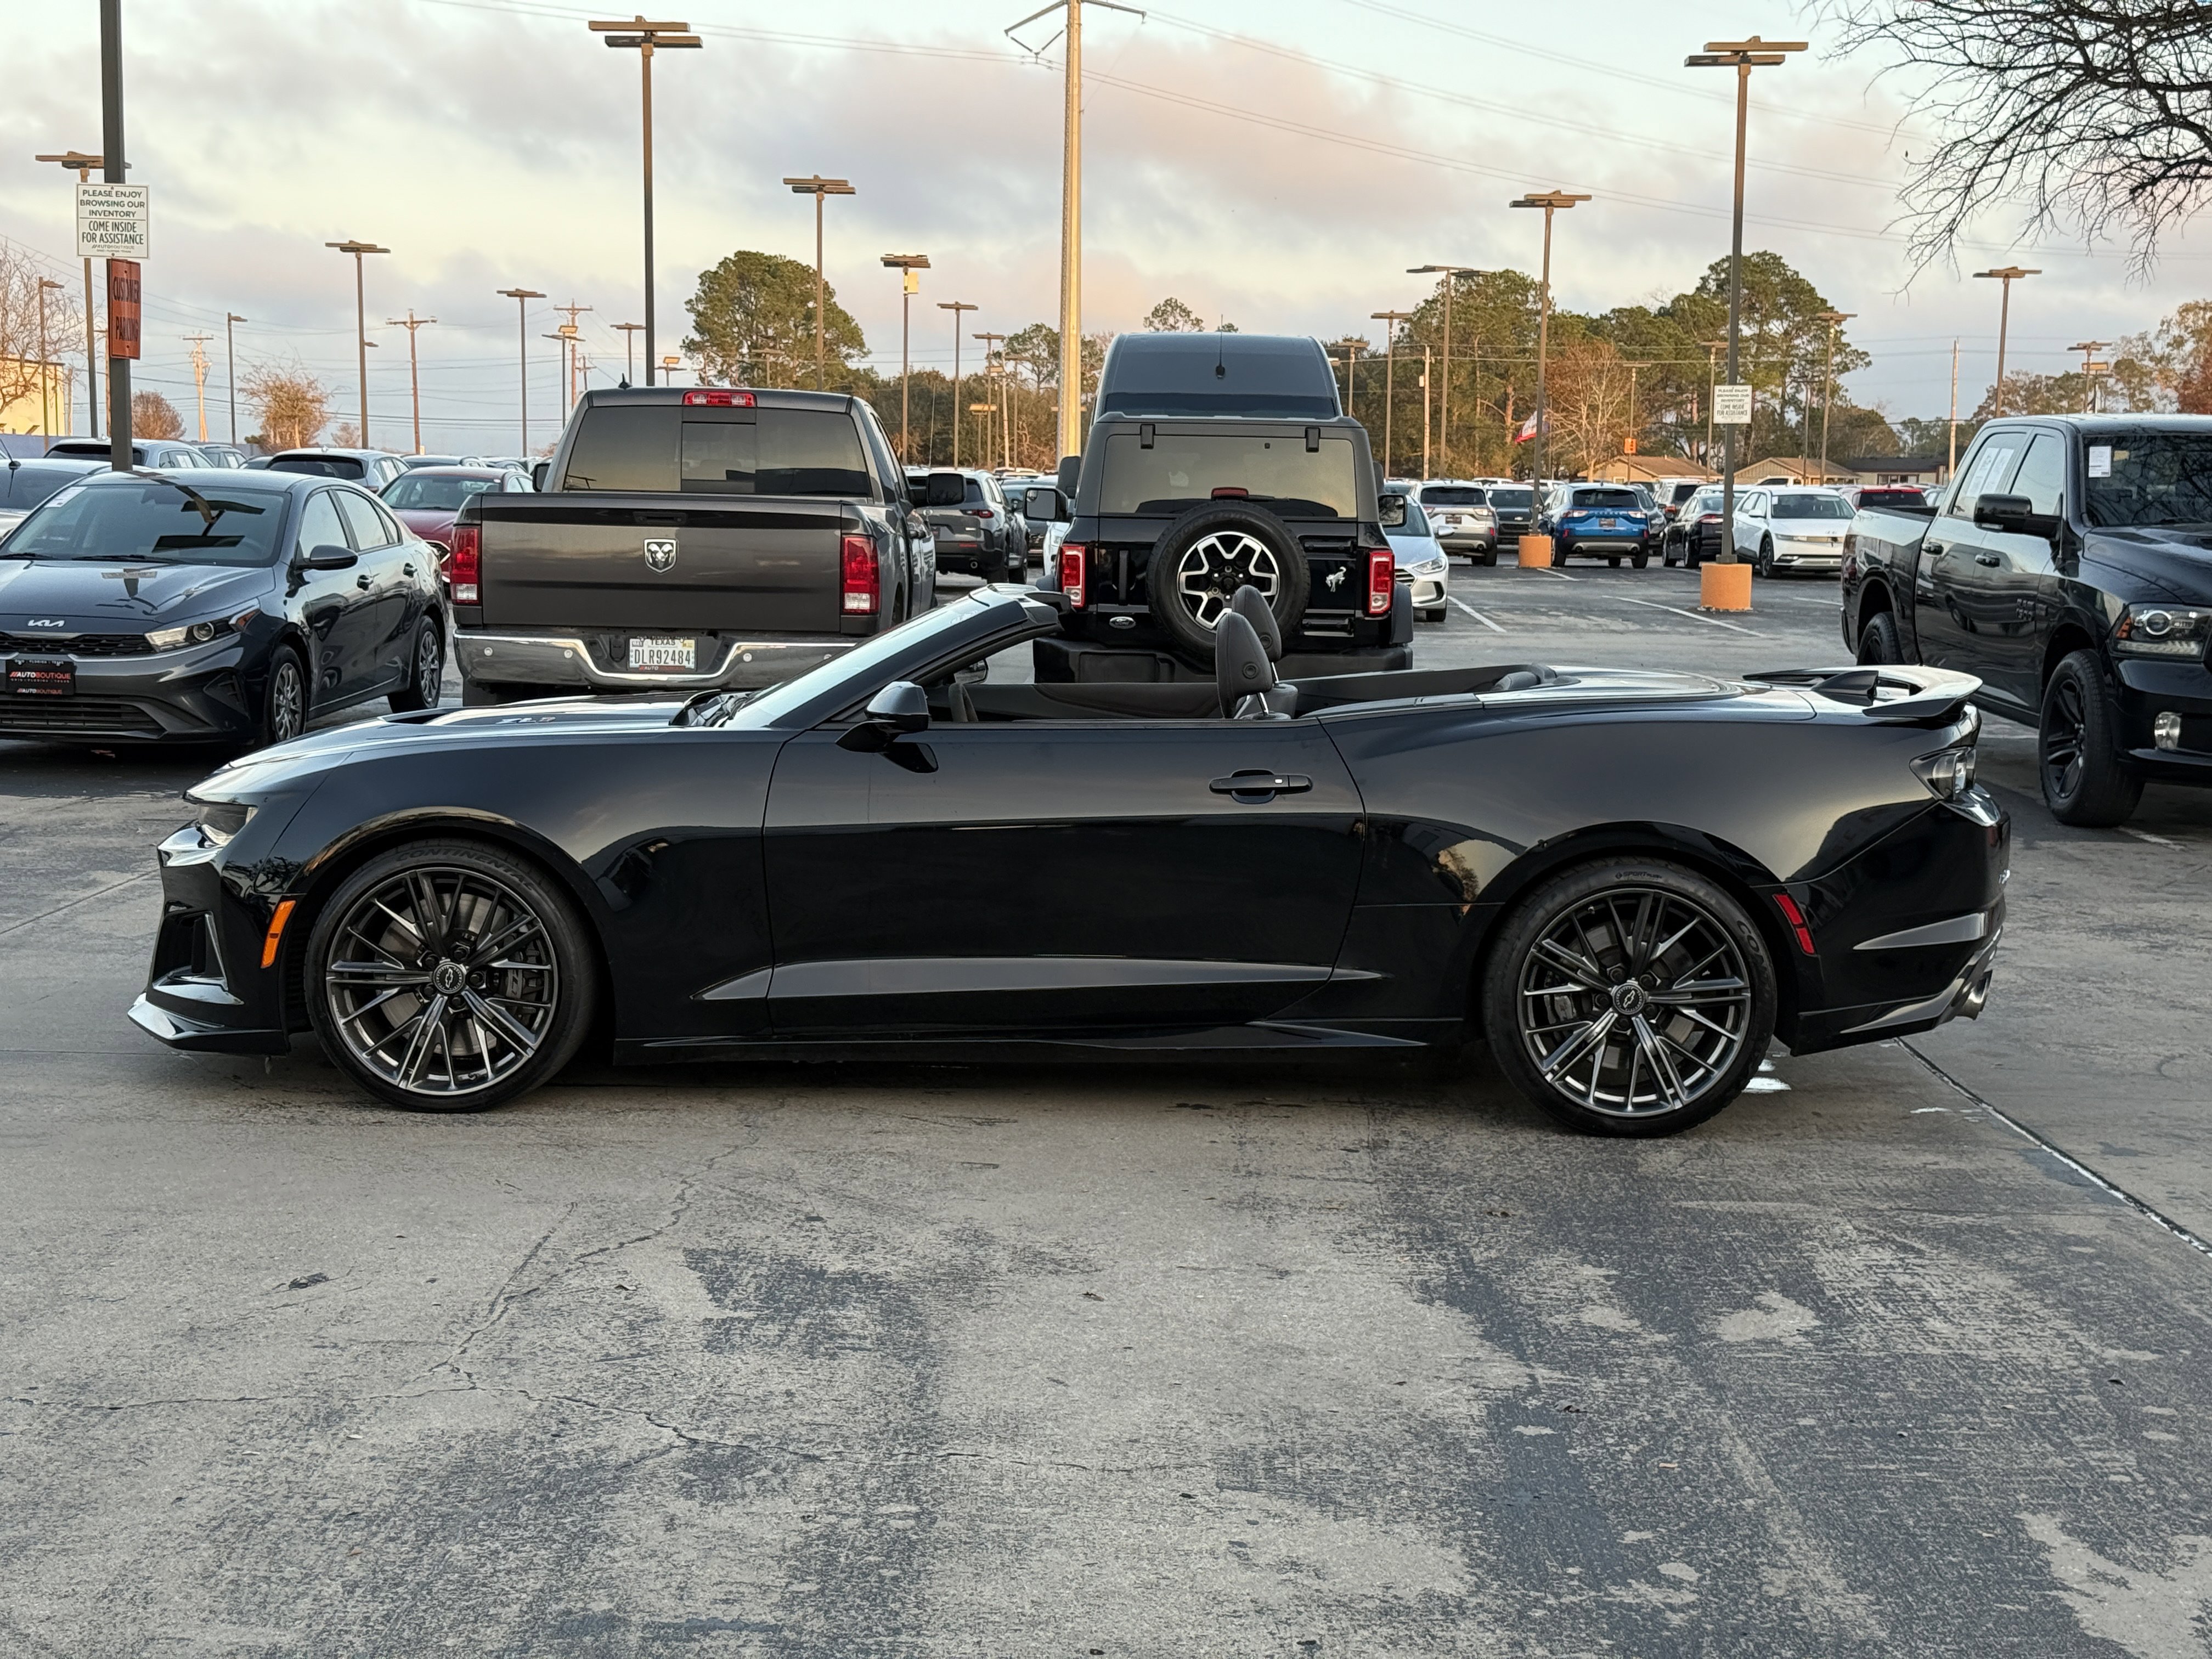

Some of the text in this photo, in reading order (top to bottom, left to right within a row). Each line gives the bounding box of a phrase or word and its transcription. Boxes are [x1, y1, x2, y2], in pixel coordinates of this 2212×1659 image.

[80, 199, 125, 207] BROWSING
[89, 209, 137, 218] INVENTORY
[88, 220, 137, 233] COME INSIDE
[82, 232, 144, 245] FOR ASSISTANCE
[634, 649, 691, 665] DLR92484
[16, 672, 71, 680] AUTOBOUTIQUE
[397, 848, 534, 891] CONTINENTAL
